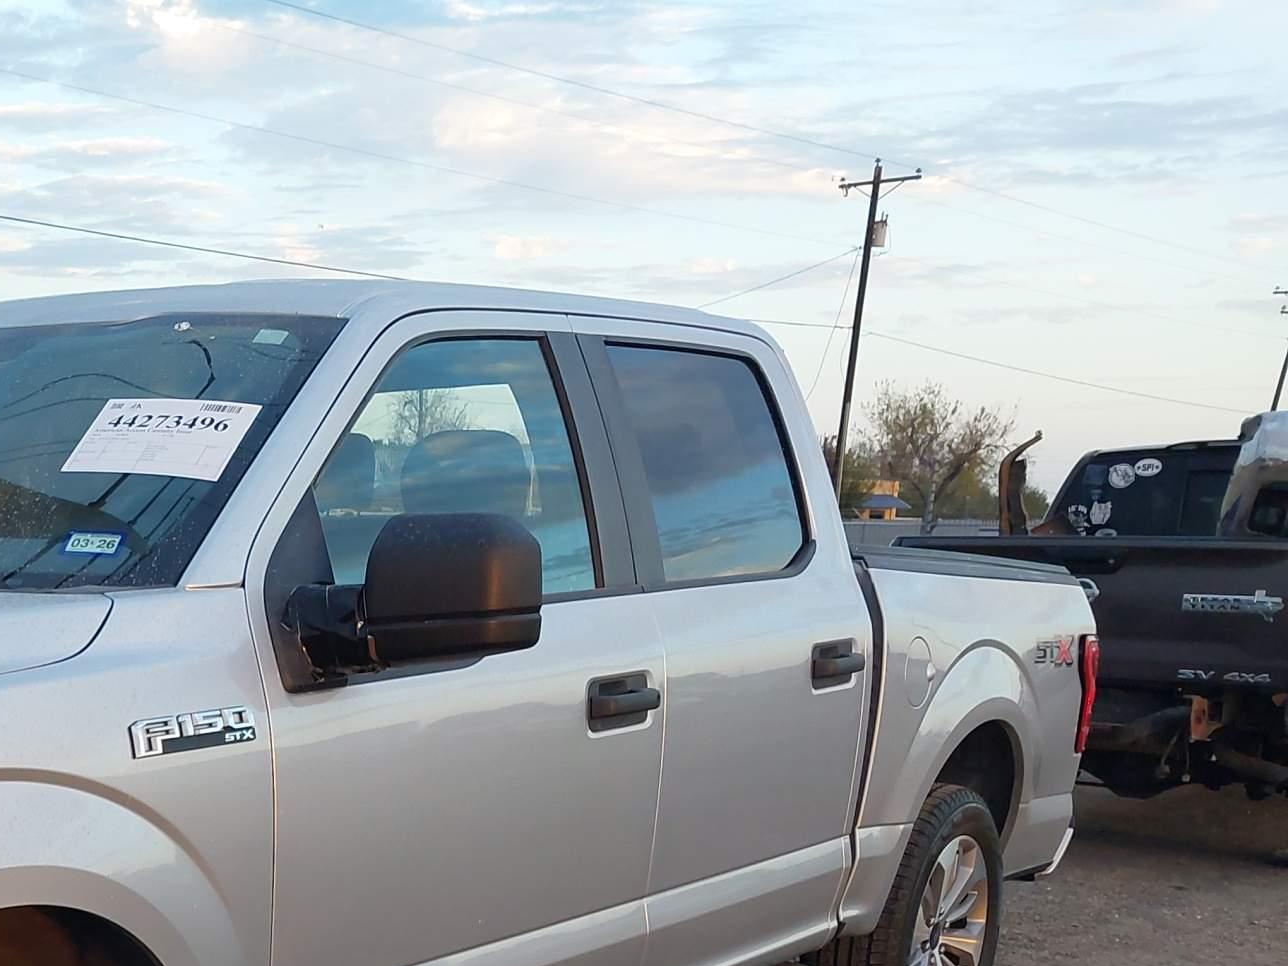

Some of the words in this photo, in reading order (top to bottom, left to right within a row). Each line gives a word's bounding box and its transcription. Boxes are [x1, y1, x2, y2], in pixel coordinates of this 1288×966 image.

[108, 414, 232, 432] 44273496
[71, 538, 90, 548] 03
[95, 538, 116, 549] 26
[1034, 635, 1074, 668] STX
[1176, 668, 1216, 681] SV
[224, 728, 255, 743] STX
